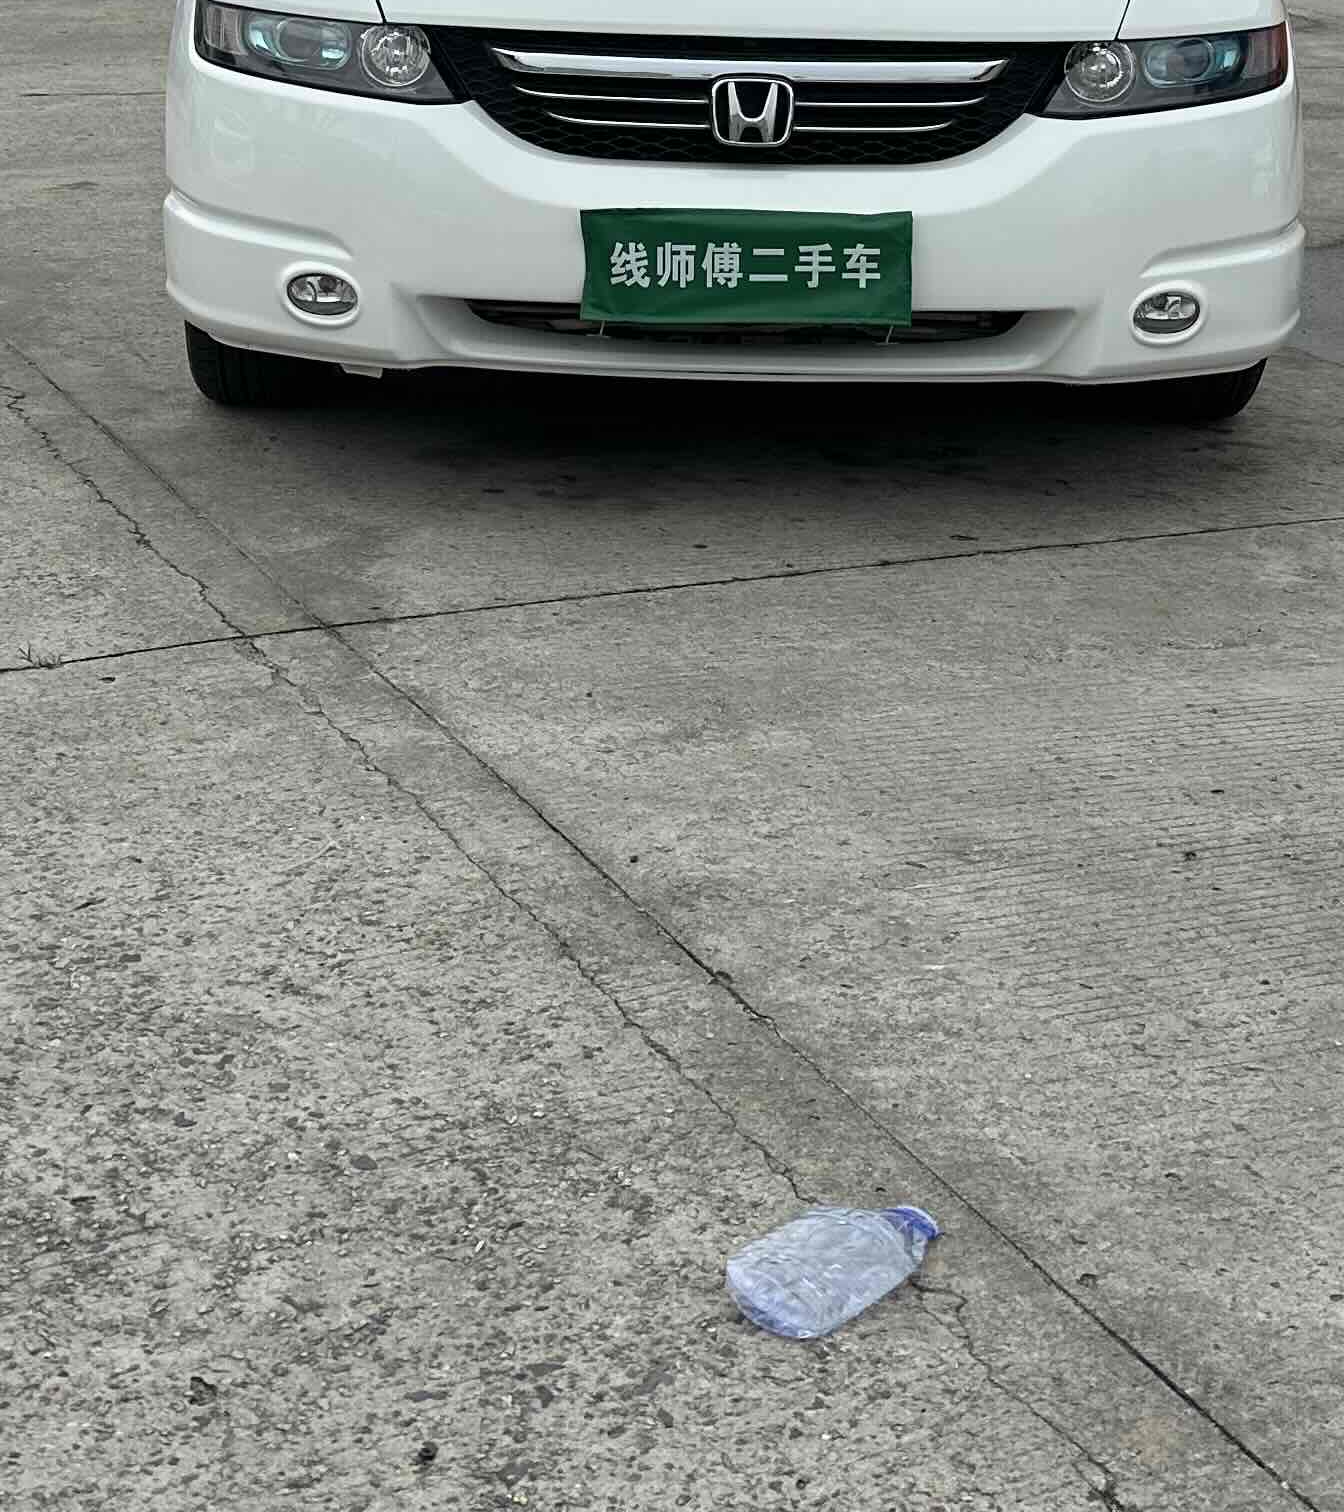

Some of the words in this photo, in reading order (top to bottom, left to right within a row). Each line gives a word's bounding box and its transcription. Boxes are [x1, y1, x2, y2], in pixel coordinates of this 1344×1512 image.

[609, 241, 882, 290] 线师傅二手车
